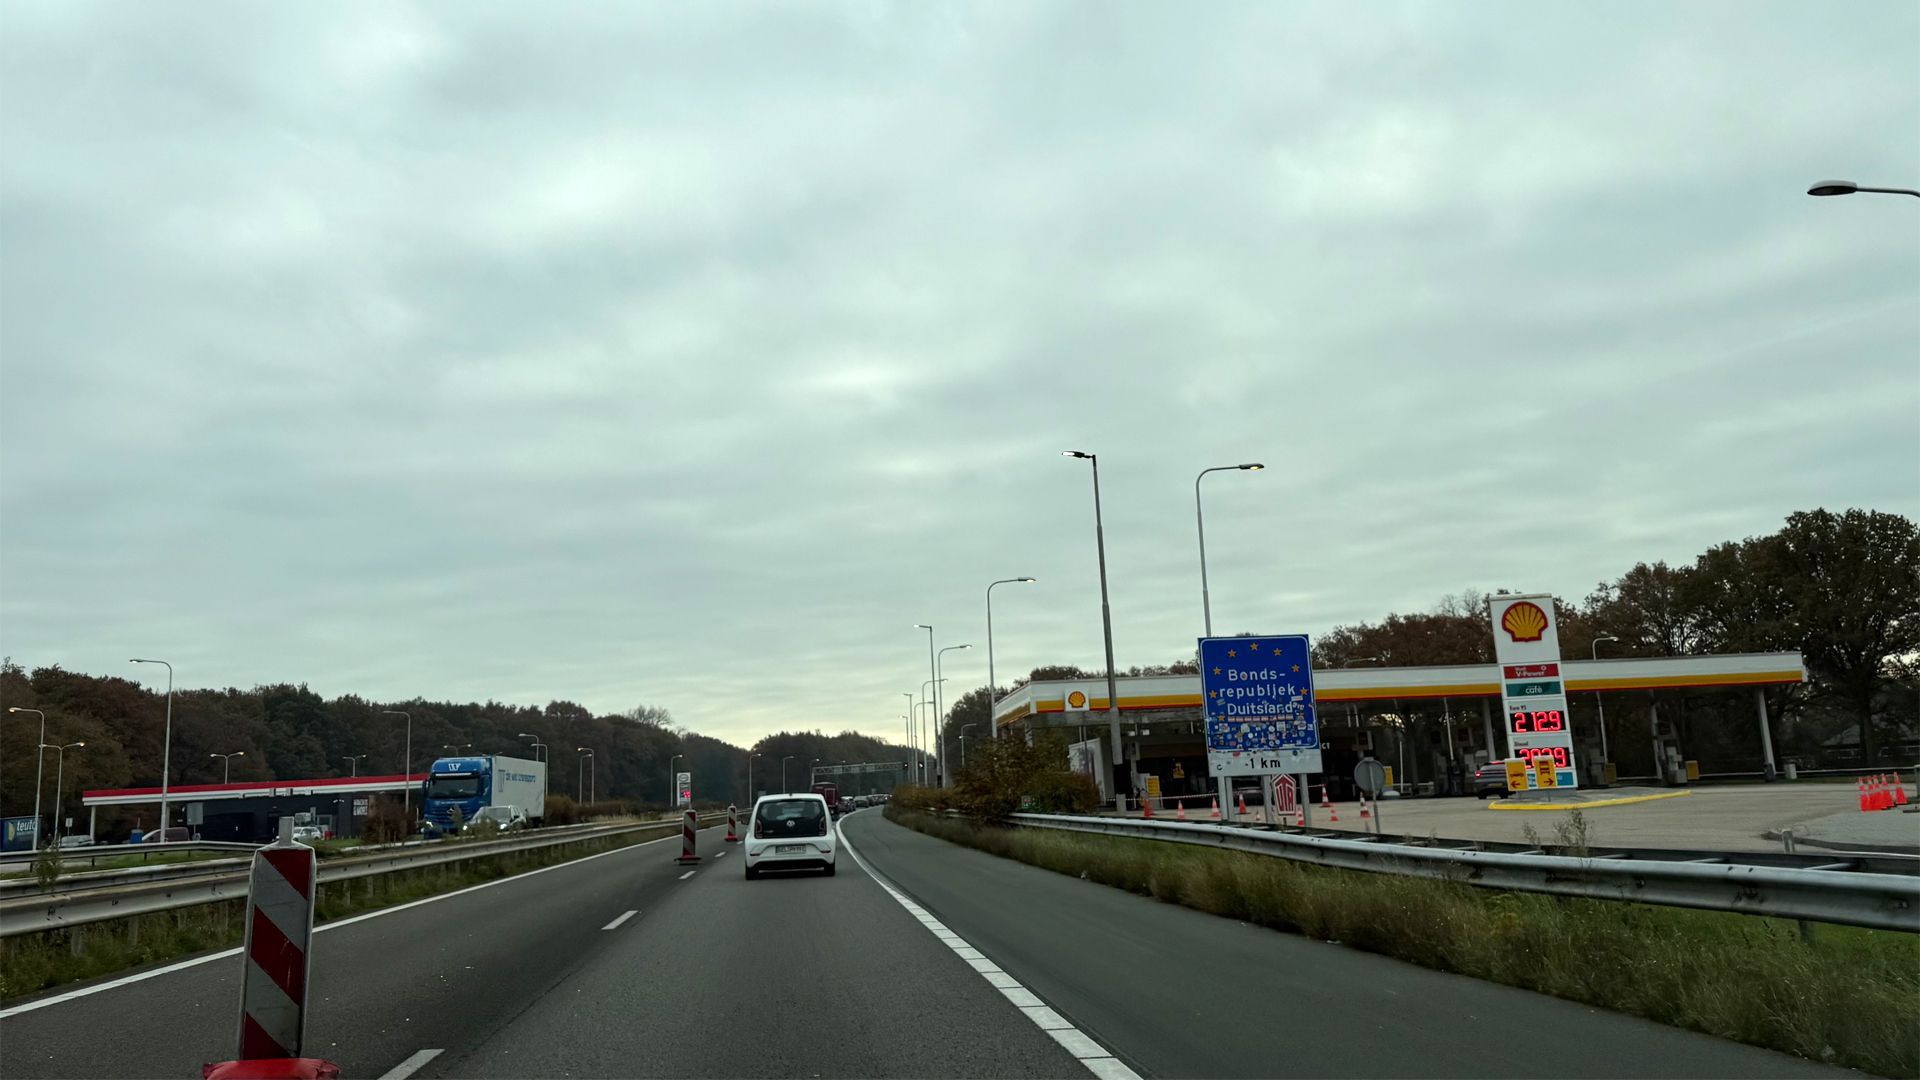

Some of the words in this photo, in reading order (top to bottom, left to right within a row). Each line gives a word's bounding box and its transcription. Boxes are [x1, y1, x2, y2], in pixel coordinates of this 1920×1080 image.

[1228, 668, 1286, 681] Bonds-
[1219, 683, 1296, 699] republiek
[1227, 702, 1293, 715] Duitsland
[1249, 758, 1255, 769] 1
[1261, 758, 1281, 768] km
